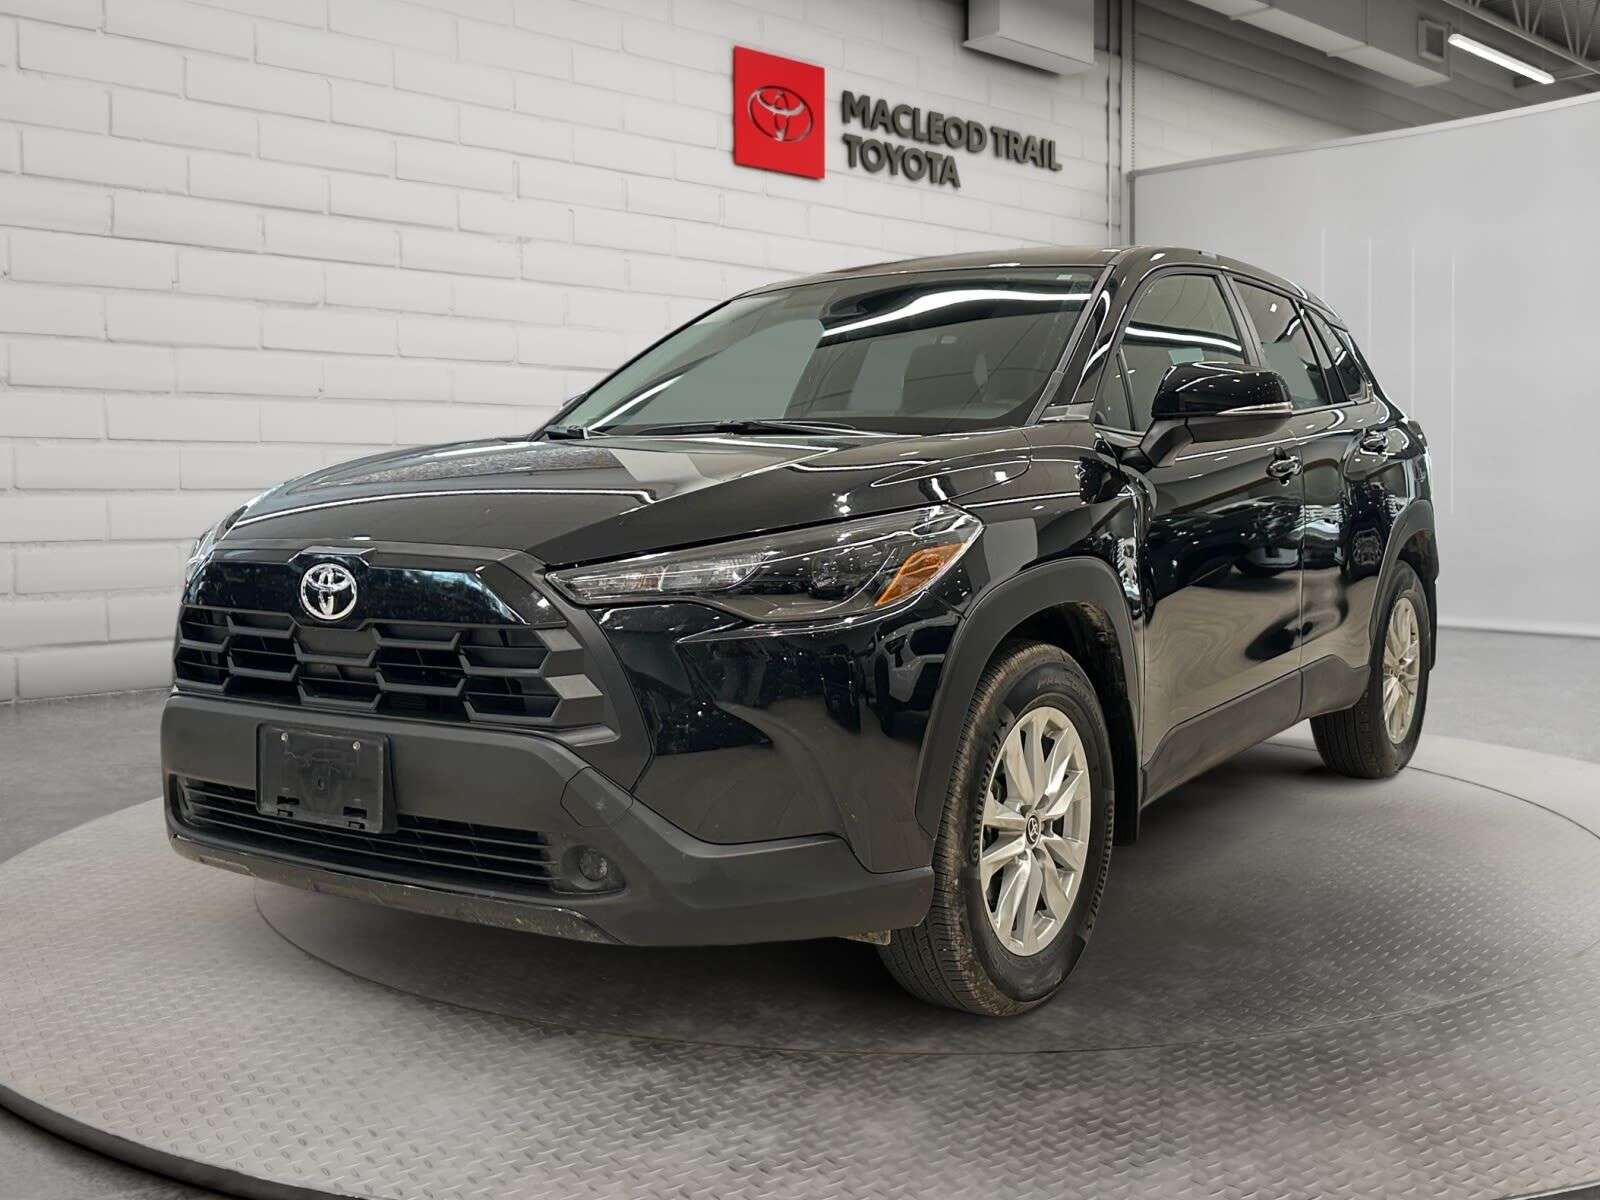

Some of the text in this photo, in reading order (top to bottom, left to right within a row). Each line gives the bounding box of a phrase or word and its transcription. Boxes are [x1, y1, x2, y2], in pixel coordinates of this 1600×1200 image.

[841, 90, 1063, 171] MACLEOD TRAIL
[842, 133, 961, 188] TOYOTA
